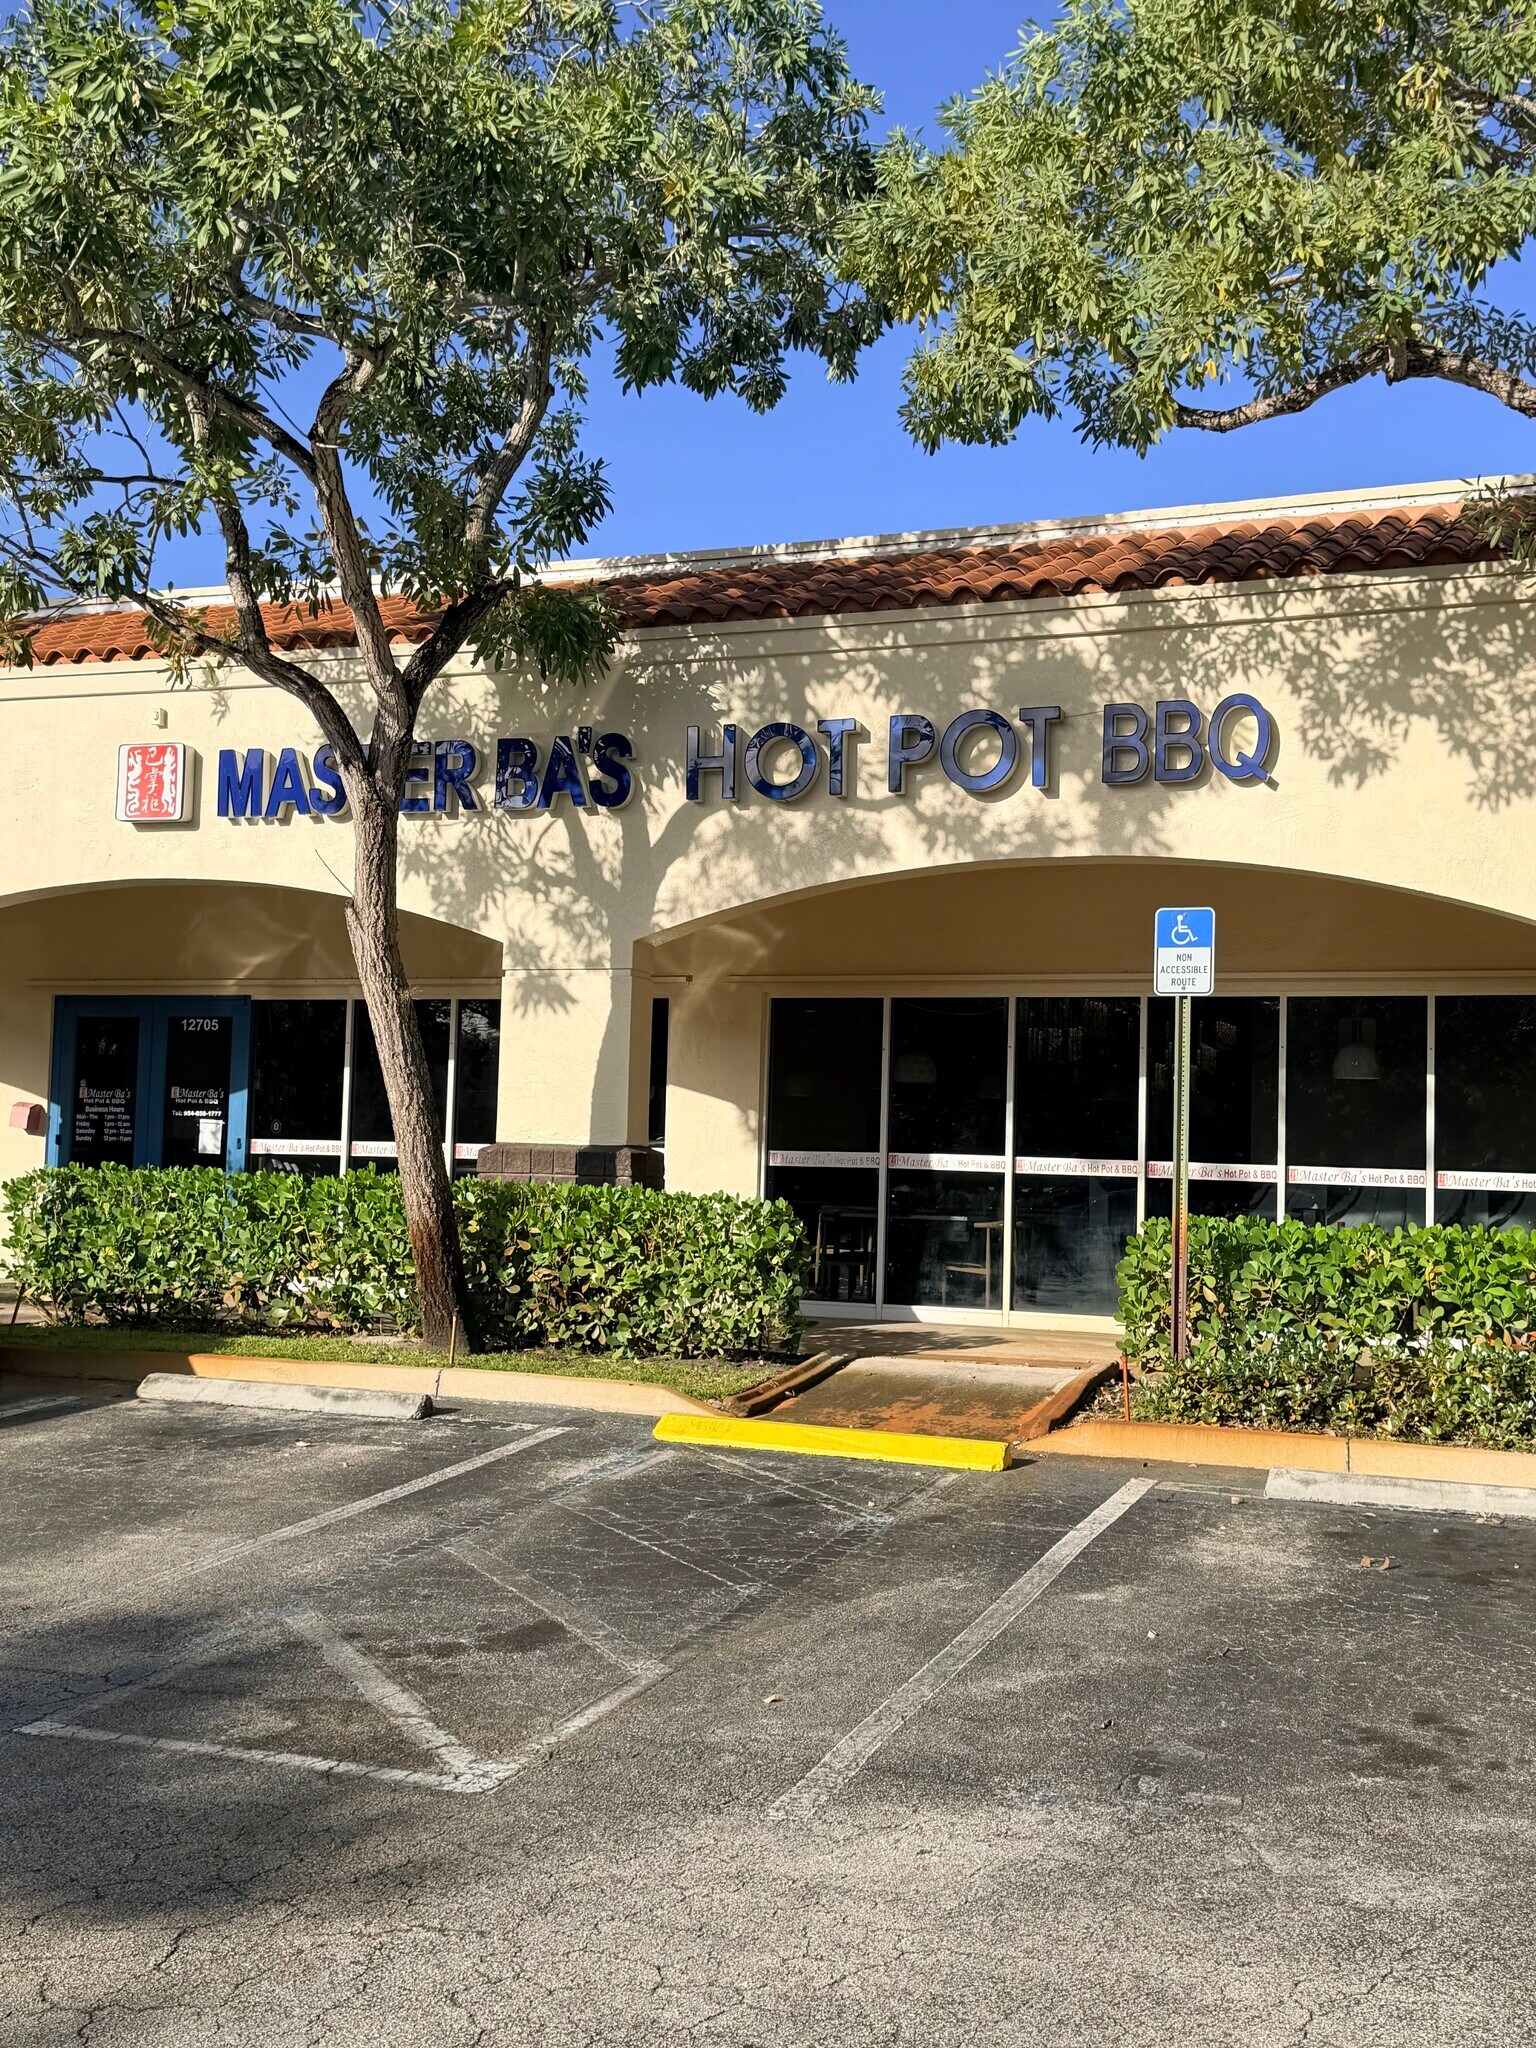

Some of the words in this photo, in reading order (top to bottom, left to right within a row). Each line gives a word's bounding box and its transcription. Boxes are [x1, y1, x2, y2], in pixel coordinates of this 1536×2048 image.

[217, 739, 476, 818] MASER
[494, 726, 637, 810] BA'S
[686, 718, 861, 801] HOT
[888, 707, 1065, 795] POT
[1101, 693, 1273, 786] BBQ
[1176, 954, 1192, 962] NON
[1160, 966, 1208, 974] ACCESSIBLE
[1171, 978, 1196, 986] ROUTE
[181, 1019, 219, 1031] 12705
[87, 1088, 114, 1098] Master
[114, 1088, 131, 1098] Ba's
[178, 1088, 207, 1098] Master
[206, 1088, 224, 1098] Ba's
[360, 1144, 388, 1154] Master
[780, 1152, 810, 1164] Master
[847, 1157, 858, 1165] Pot
[866, 1156, 880, 1165] BBQ
[899, 1156, 933, 1168] Master
[959, 1160, 969, 1168] Hot
[991, 1161, 1006, 1169] BBQ
[1025, 1160, 1061, 1172] Master
[1063, 1161, 1086, 1173] Ba's
[1088, 1164, 1099, 1173] Hot
[1101, 1164, 1113, 1173] Pot
[1115, 1165, 1120, 1173] &
[1122, 1165, 1138, 1174] BBQ
[1199, 1165, 1222, 1178] Ba's
[1224, 1169, 1237, 1178] Hot
[1239, 1170, 1251, 1178] Pot
[1253, 1170, 1258, 1179] &
[1261, 1170, 1277, 1179] BBQ
[1300, 1169, 1340, 1182] Master
[1341, 1170, 1366, 1183] Ba's
[1368, 1174, 1382, 1183] Hot
[1384, 1174, 1397, 1184] Pot
[1399, 1175, 1405, 1184] &
[1408, 1175, 1425, 1184] BBQ
[1448, 1174, 1491, 1187] Master
[1492, 1175, 1520, 1188] Ba's
